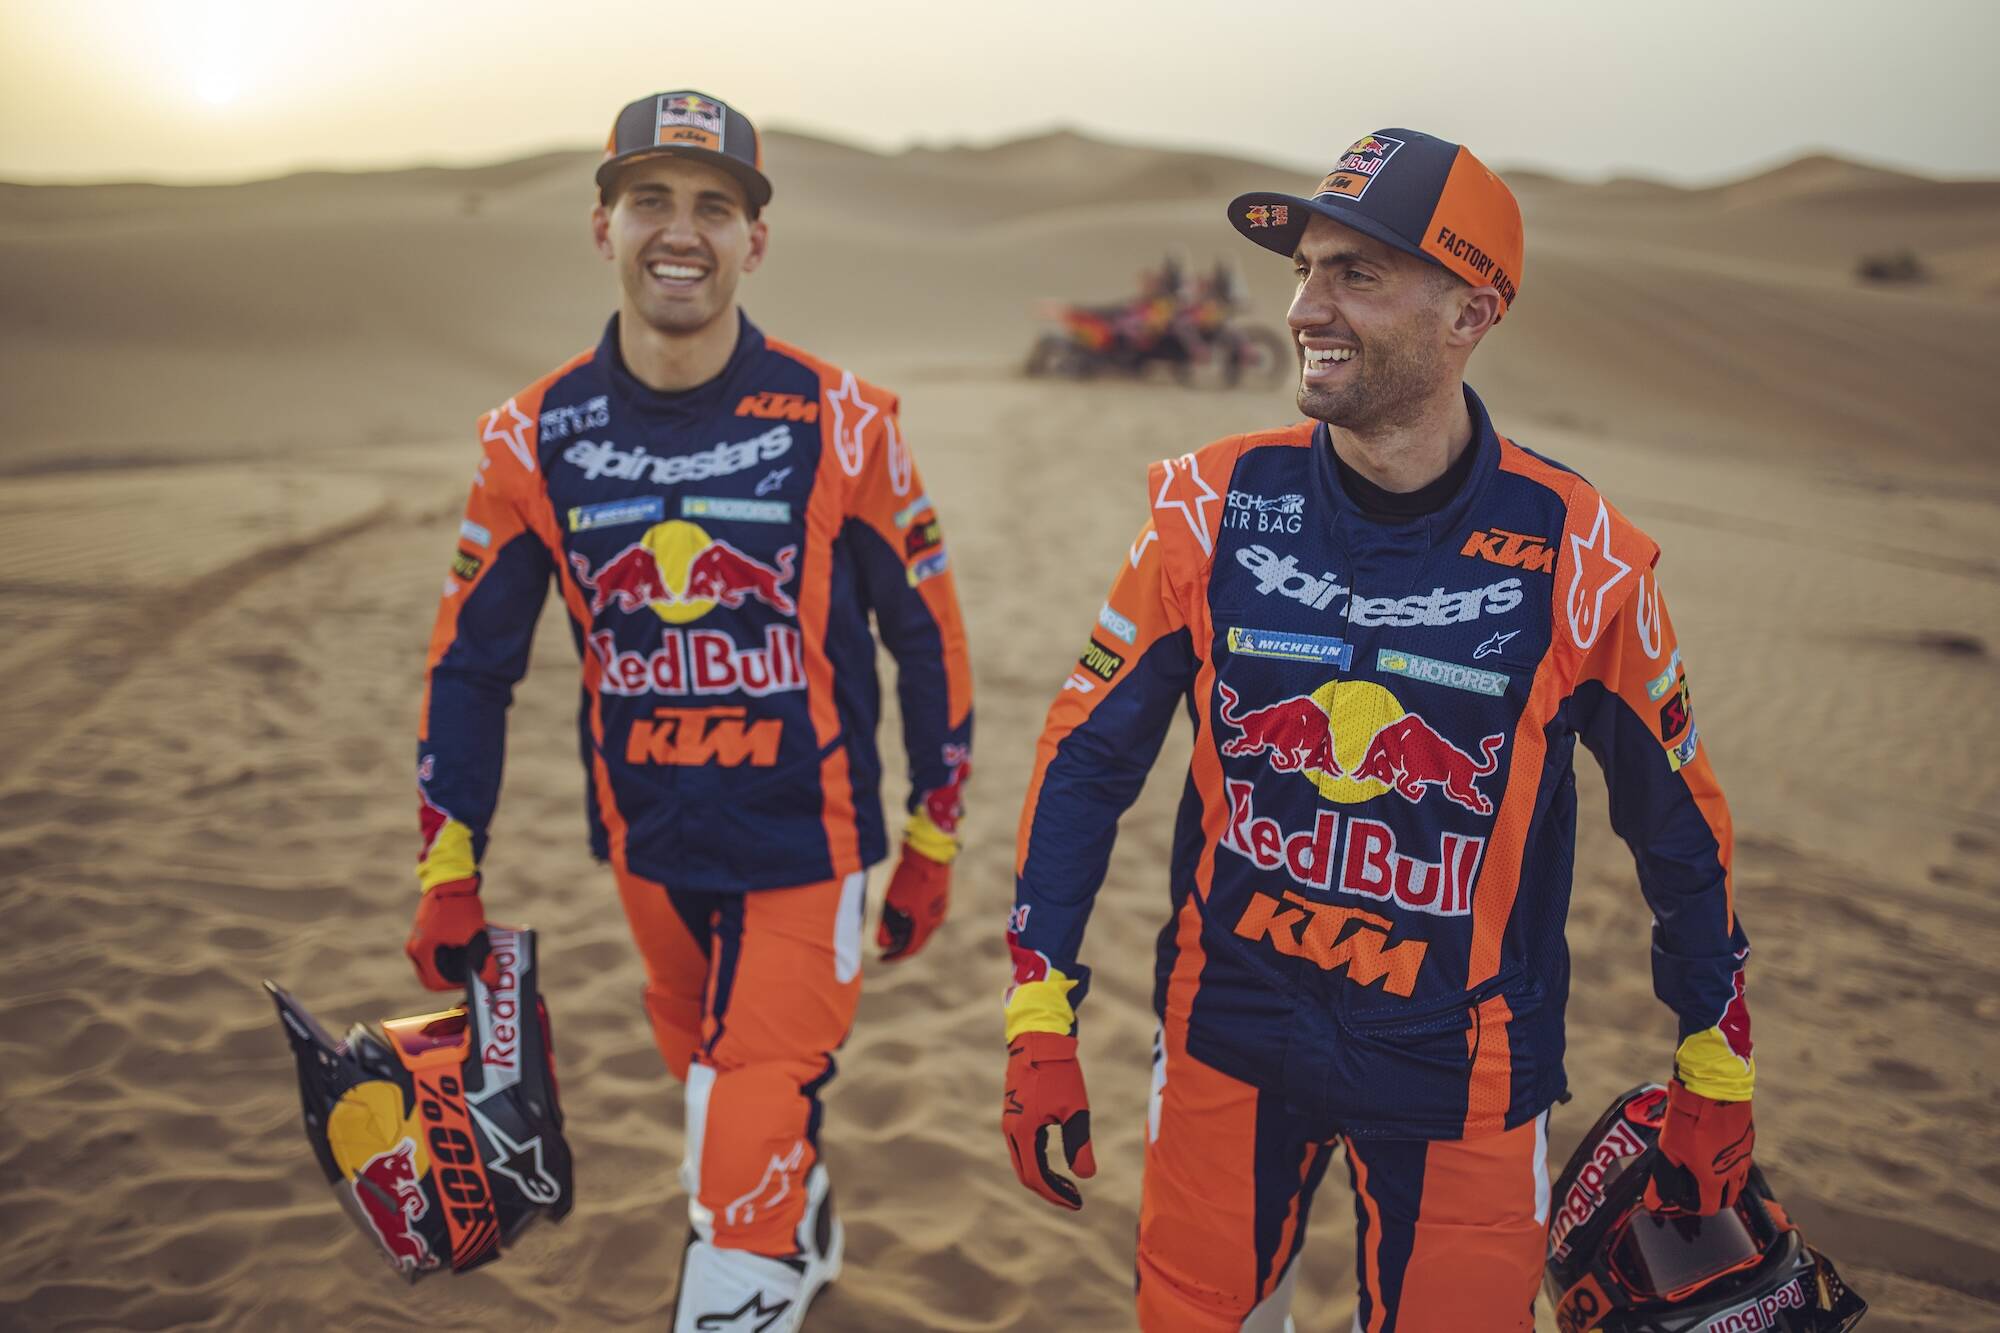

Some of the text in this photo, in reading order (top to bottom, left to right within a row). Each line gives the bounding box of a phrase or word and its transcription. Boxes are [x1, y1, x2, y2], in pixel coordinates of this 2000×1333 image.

[1437, 226, 1516, 309] FACTORY RACIN
[734, 391, 818, 424] KTM
[563, 424, 793, 485] alpinestars
[1258, 512, 1302, 534] BAG
[1460, 527, 1557, 574] KTM
[1235, 544, 1524, 627] alpinestars
[589, 623, 808, 697] Red Bull
[1258, 639, 1341, 656] MICHELIN
[1409, 657, 1503, 693] MOTOREX
[626, 706, 784, 767] KTM
[1219, 777, 1485, 917] Red Bull
[1233, 889, 1429, 998] KTM
[419, 1075, 491, 1230] 100%
[1578, 1118, 1648, 1208] Red
[1759, 1278, 1806, 1326] Red
